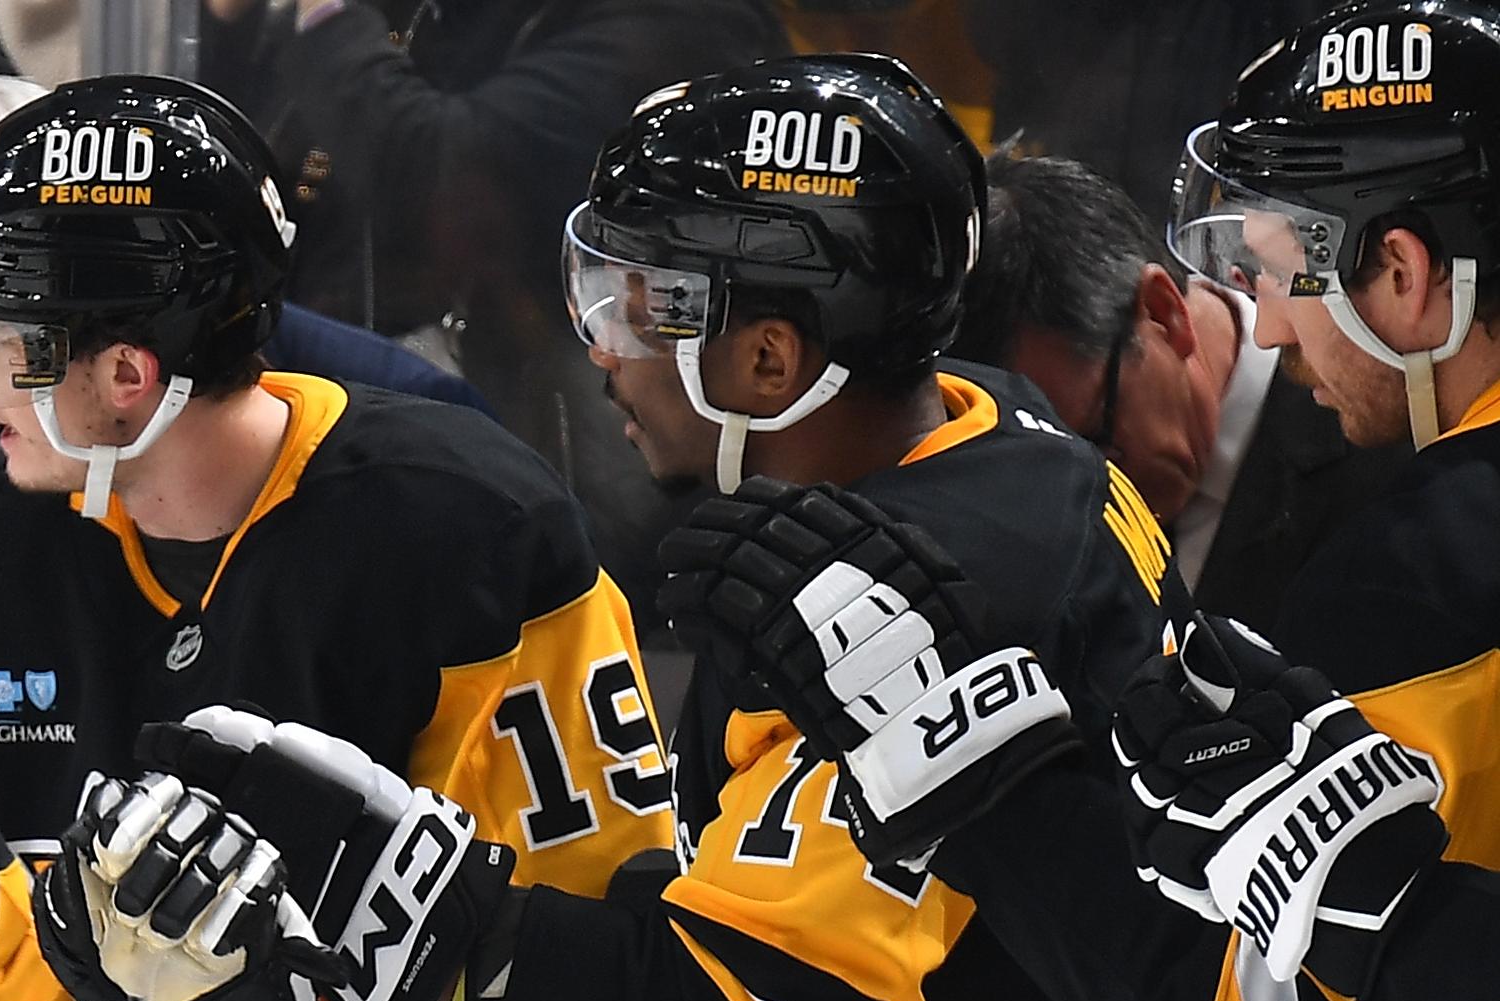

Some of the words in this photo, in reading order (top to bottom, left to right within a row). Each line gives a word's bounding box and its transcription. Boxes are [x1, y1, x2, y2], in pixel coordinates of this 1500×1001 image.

[1318, 23, 1432, 88] BOLD
[1322, 84, 1433, 112] PENGUIN
[41, 127, 154, 182] BOLD
[744, 110, 862, 173] BOLD
[40, 185, 151, 205] PENGUIN
[742, 171, 857, 197] PENGUIN
[490, 651, 672, 852] 19
[1184, 737, 1251, 764] COVERT
[403, 933, 436, 992] PENGUINS
